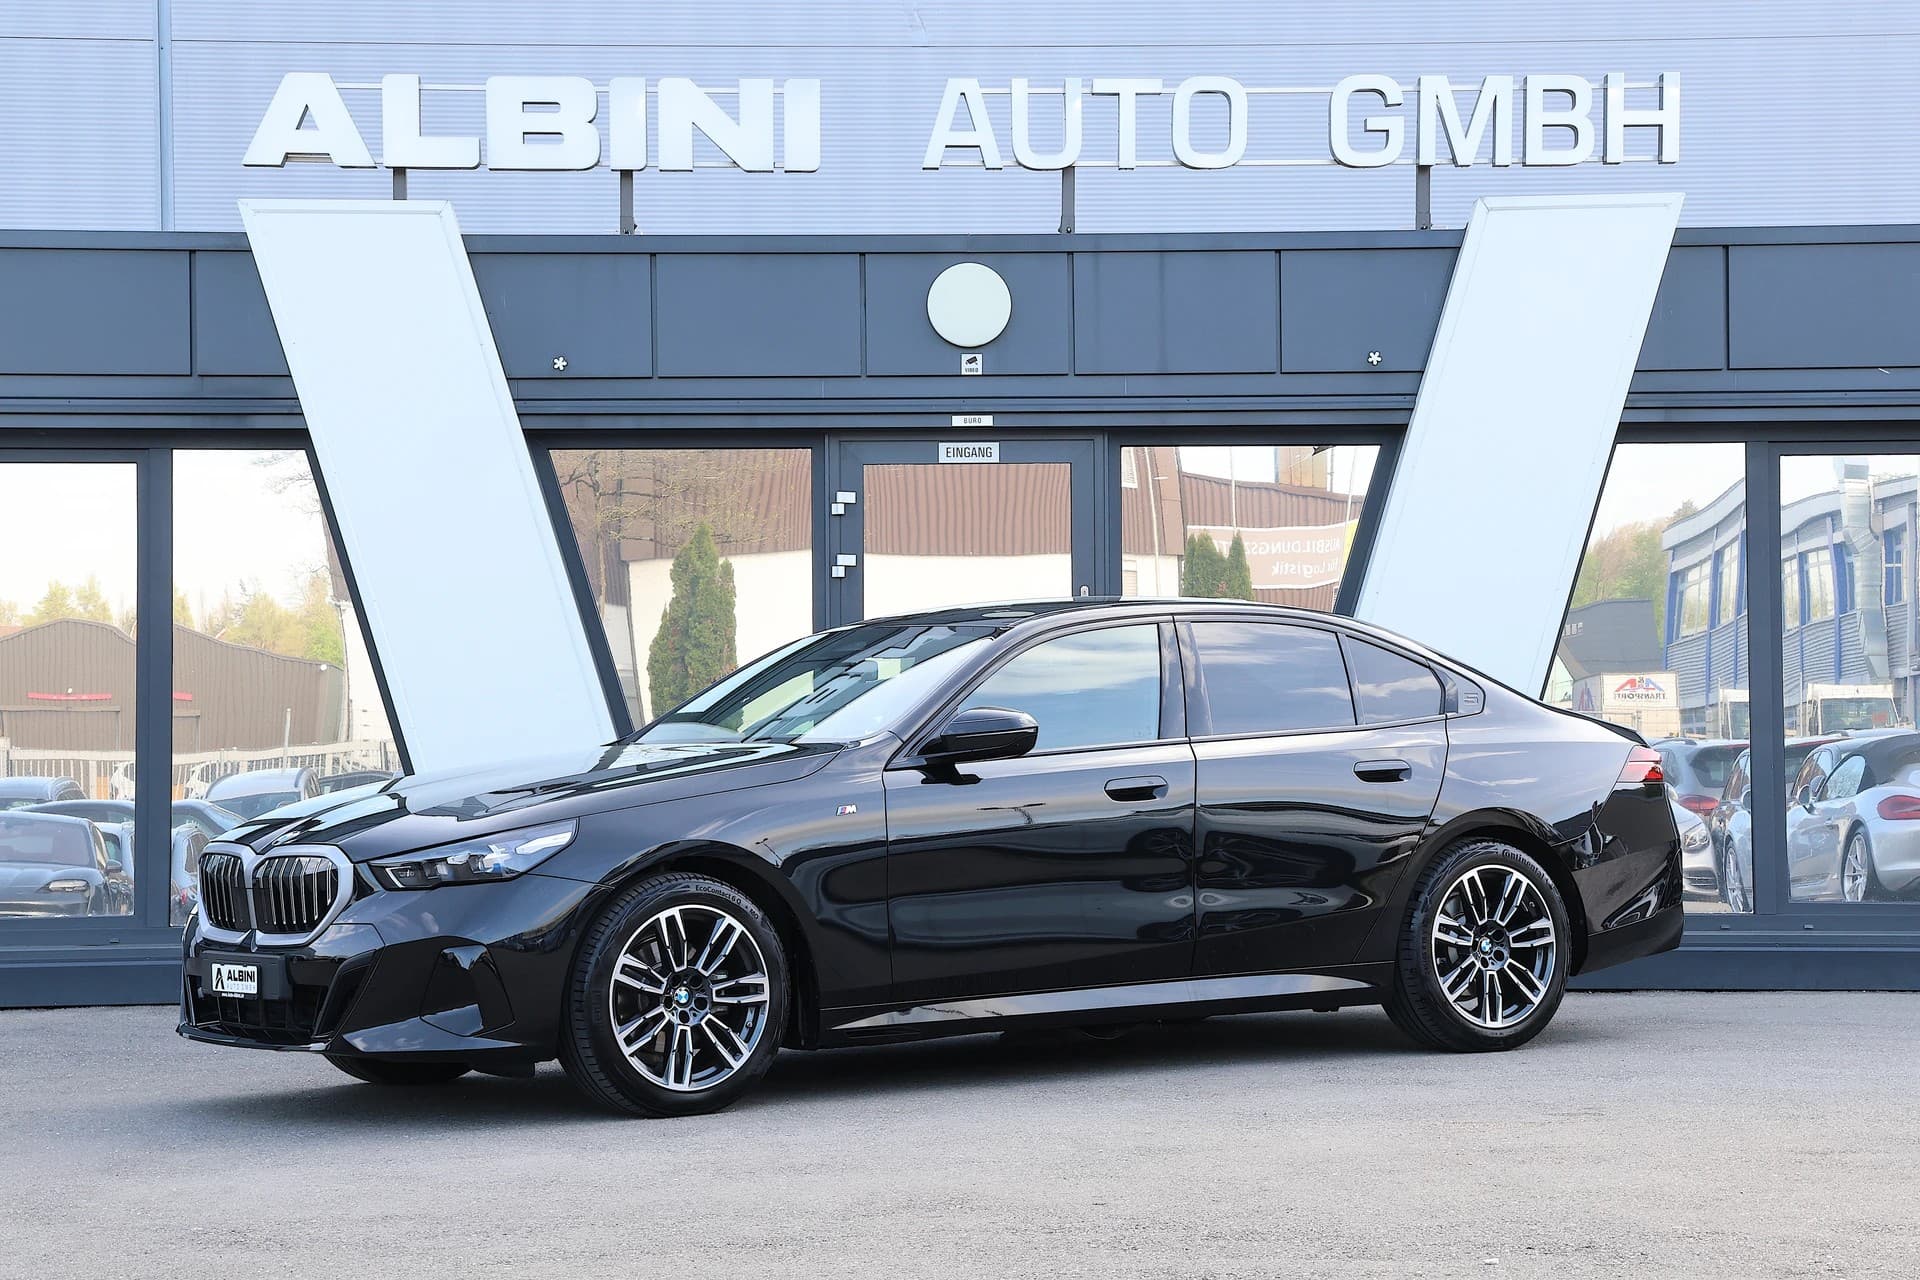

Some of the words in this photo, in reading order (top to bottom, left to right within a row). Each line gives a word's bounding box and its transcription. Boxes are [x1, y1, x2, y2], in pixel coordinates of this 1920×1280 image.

[242, 71, 821, 173] ALBINI
[922, 75, 1248, 171] AUTO
[1328, 71, 1681, 168] GMBH
[945, 446, 992, 458] EINGANG
[1502, 848, 1545, 879] Continental
[695, 884, 731, 899] EcoContact
[227, 969, 255, 982] ALBINI
